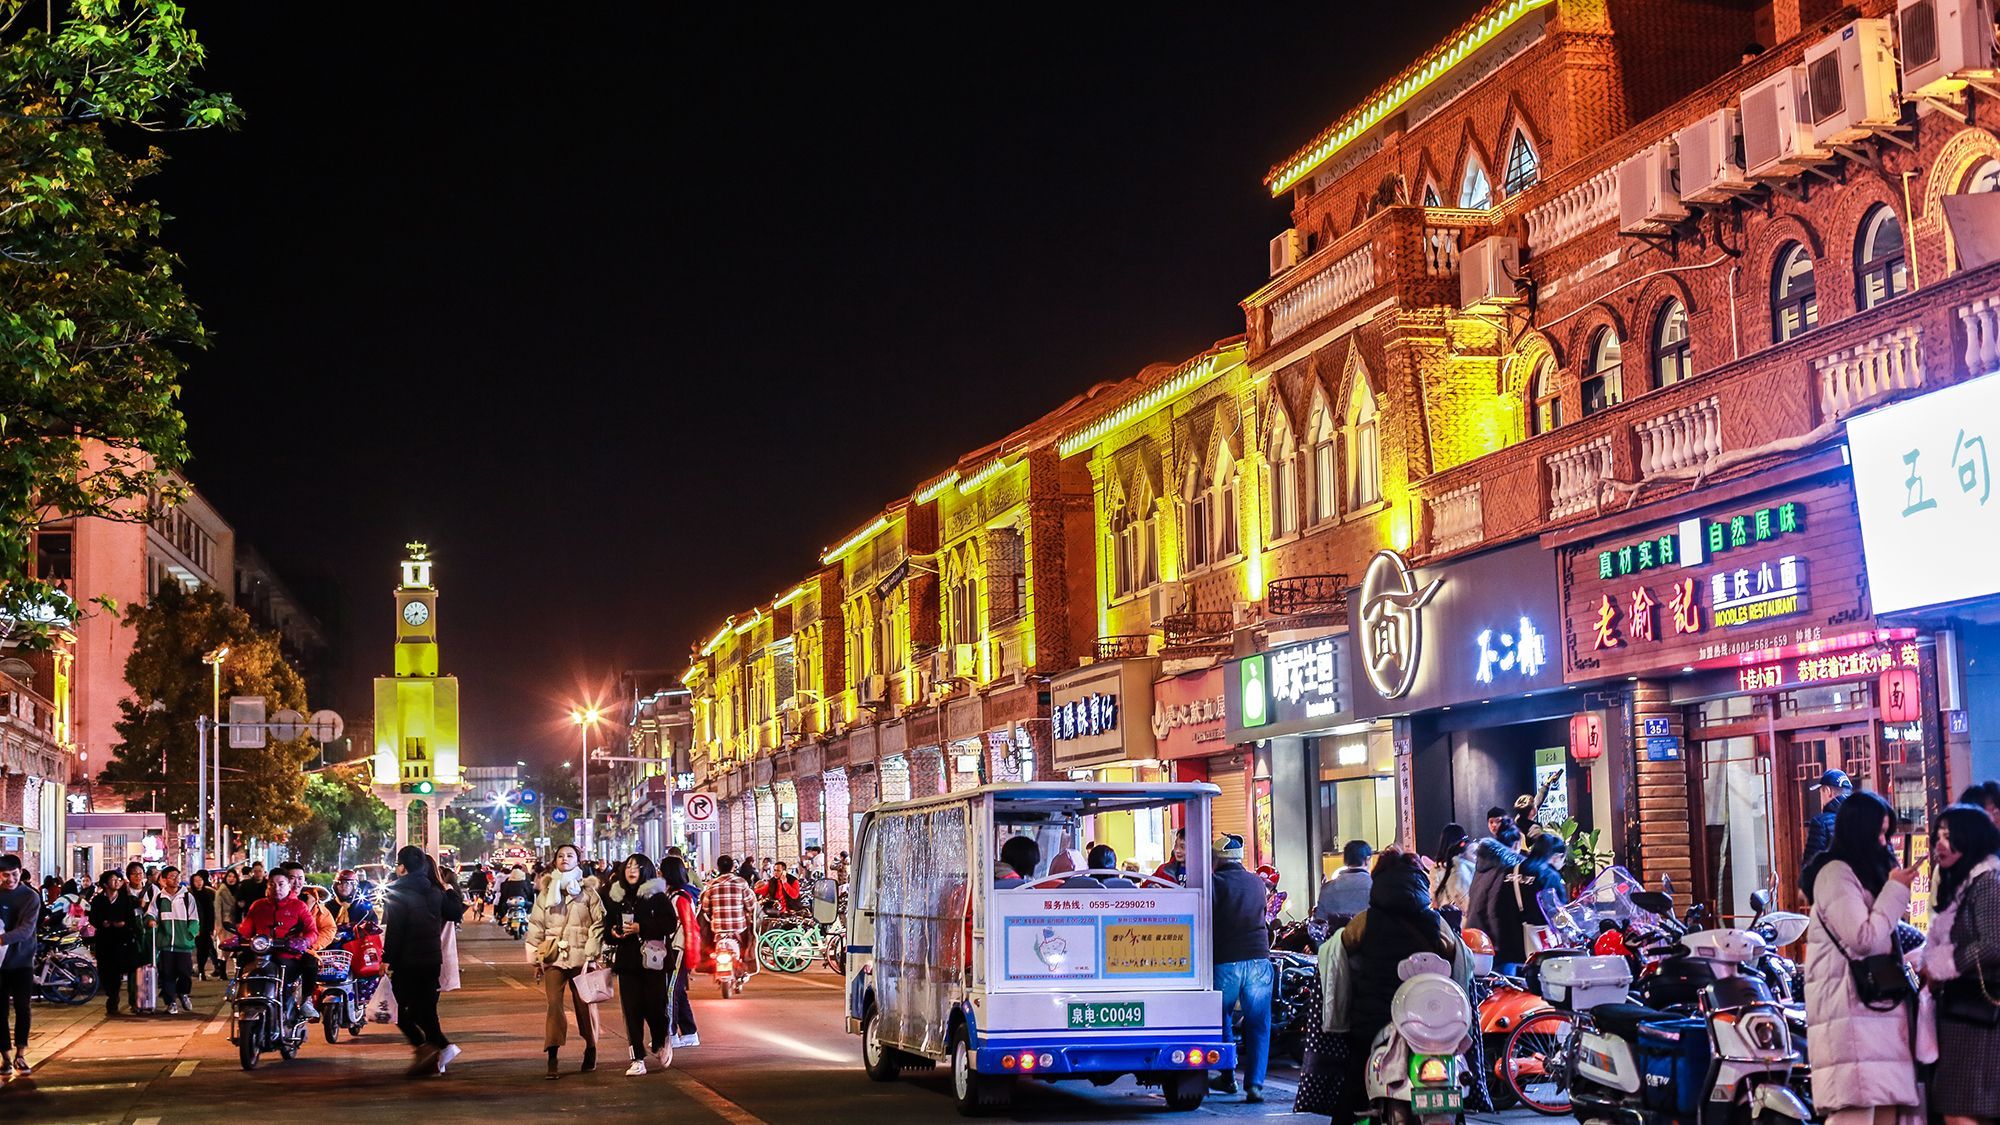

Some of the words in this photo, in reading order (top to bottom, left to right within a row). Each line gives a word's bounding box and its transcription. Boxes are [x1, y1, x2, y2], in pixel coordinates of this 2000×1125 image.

[1902, 428, 1991, 518] 五句
[1599, 534, 1674, 580] 真材实料
[1709, 502, 1796, 552] 自然原味
[1711, 555, 1797, 602] 重庆小面
[1715, 604, 1748, 627] NOODLES
[1749, 596, 1798, 620] RESTAURANT
[1795, 626, 1822, 643] 钟楼店
[1890, 681, 1904, 710] 面
[1650, 725, 1662, 734] 35
[1089, 900, 1156, 909] 0595-22990219
